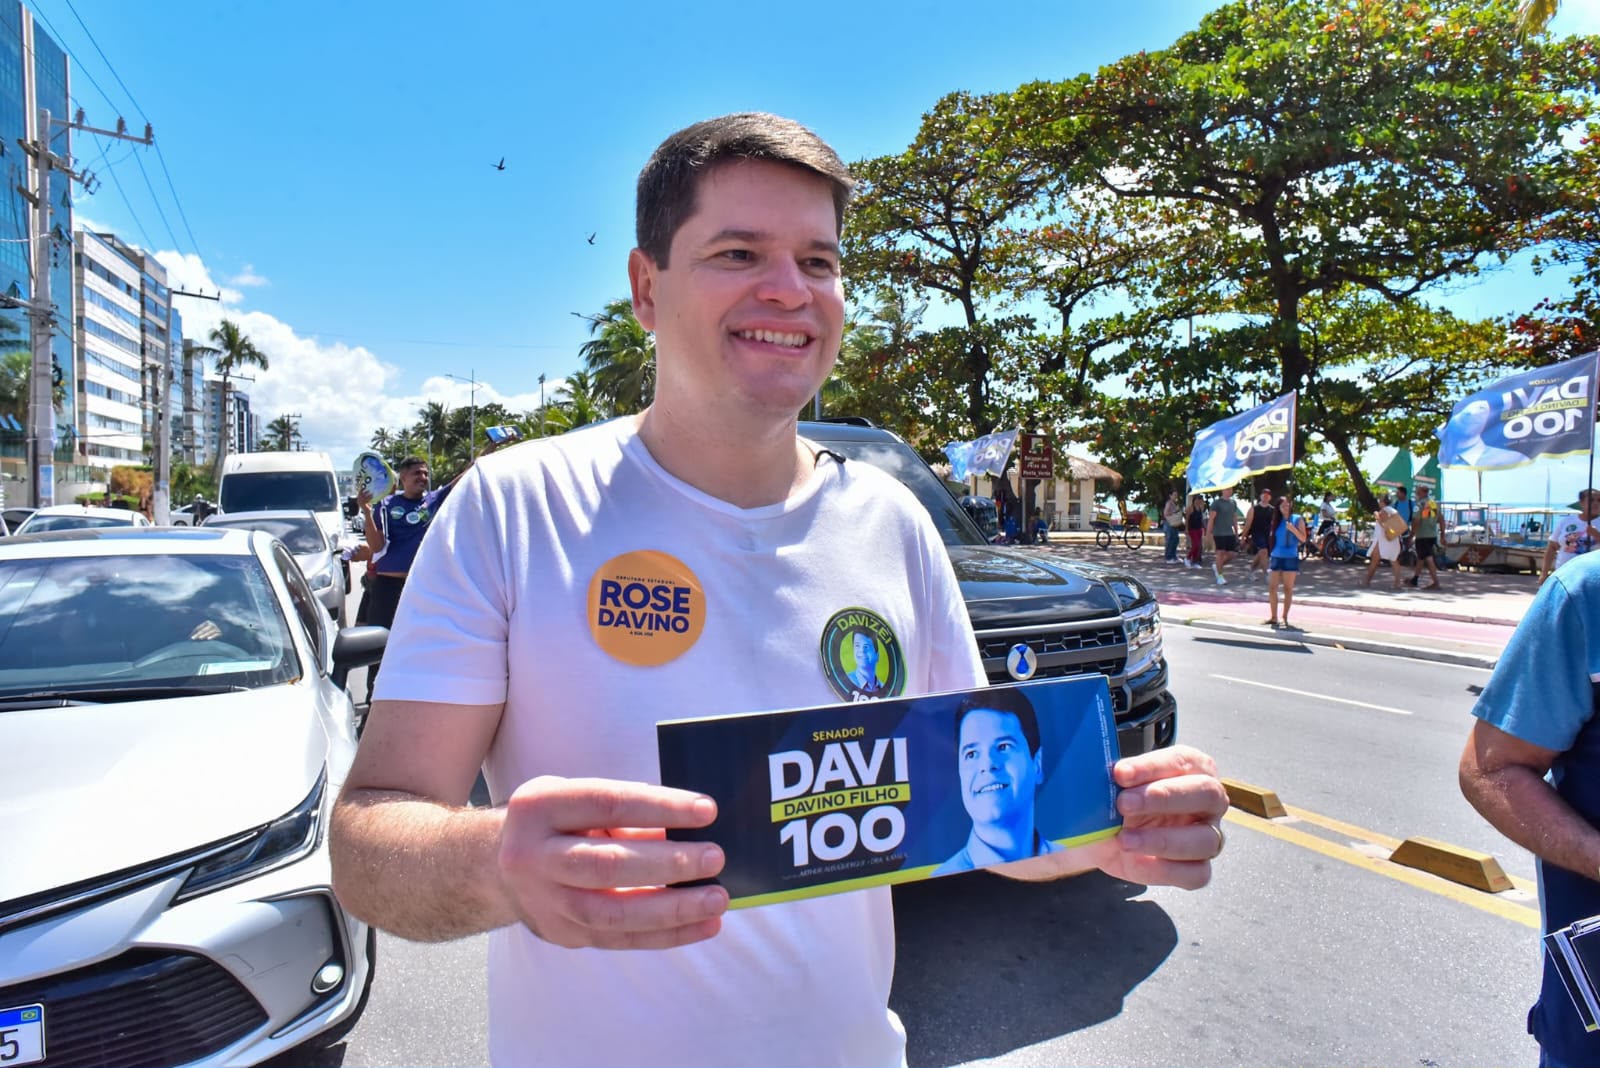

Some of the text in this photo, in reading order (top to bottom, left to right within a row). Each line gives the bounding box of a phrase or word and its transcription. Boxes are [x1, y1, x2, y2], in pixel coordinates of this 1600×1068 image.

[599, 579, 691, 615] ROSE
[598, 608, 690, 634] DAVINO
[836, 614, 892, 645] DAVIZEI
[812, 727, 865, 742] SENADOR
[768, 737, 909, 803] DAVI
[784, 787, 899, 817] DAVINO FILHO
[780, 805, 906, 867] 100
